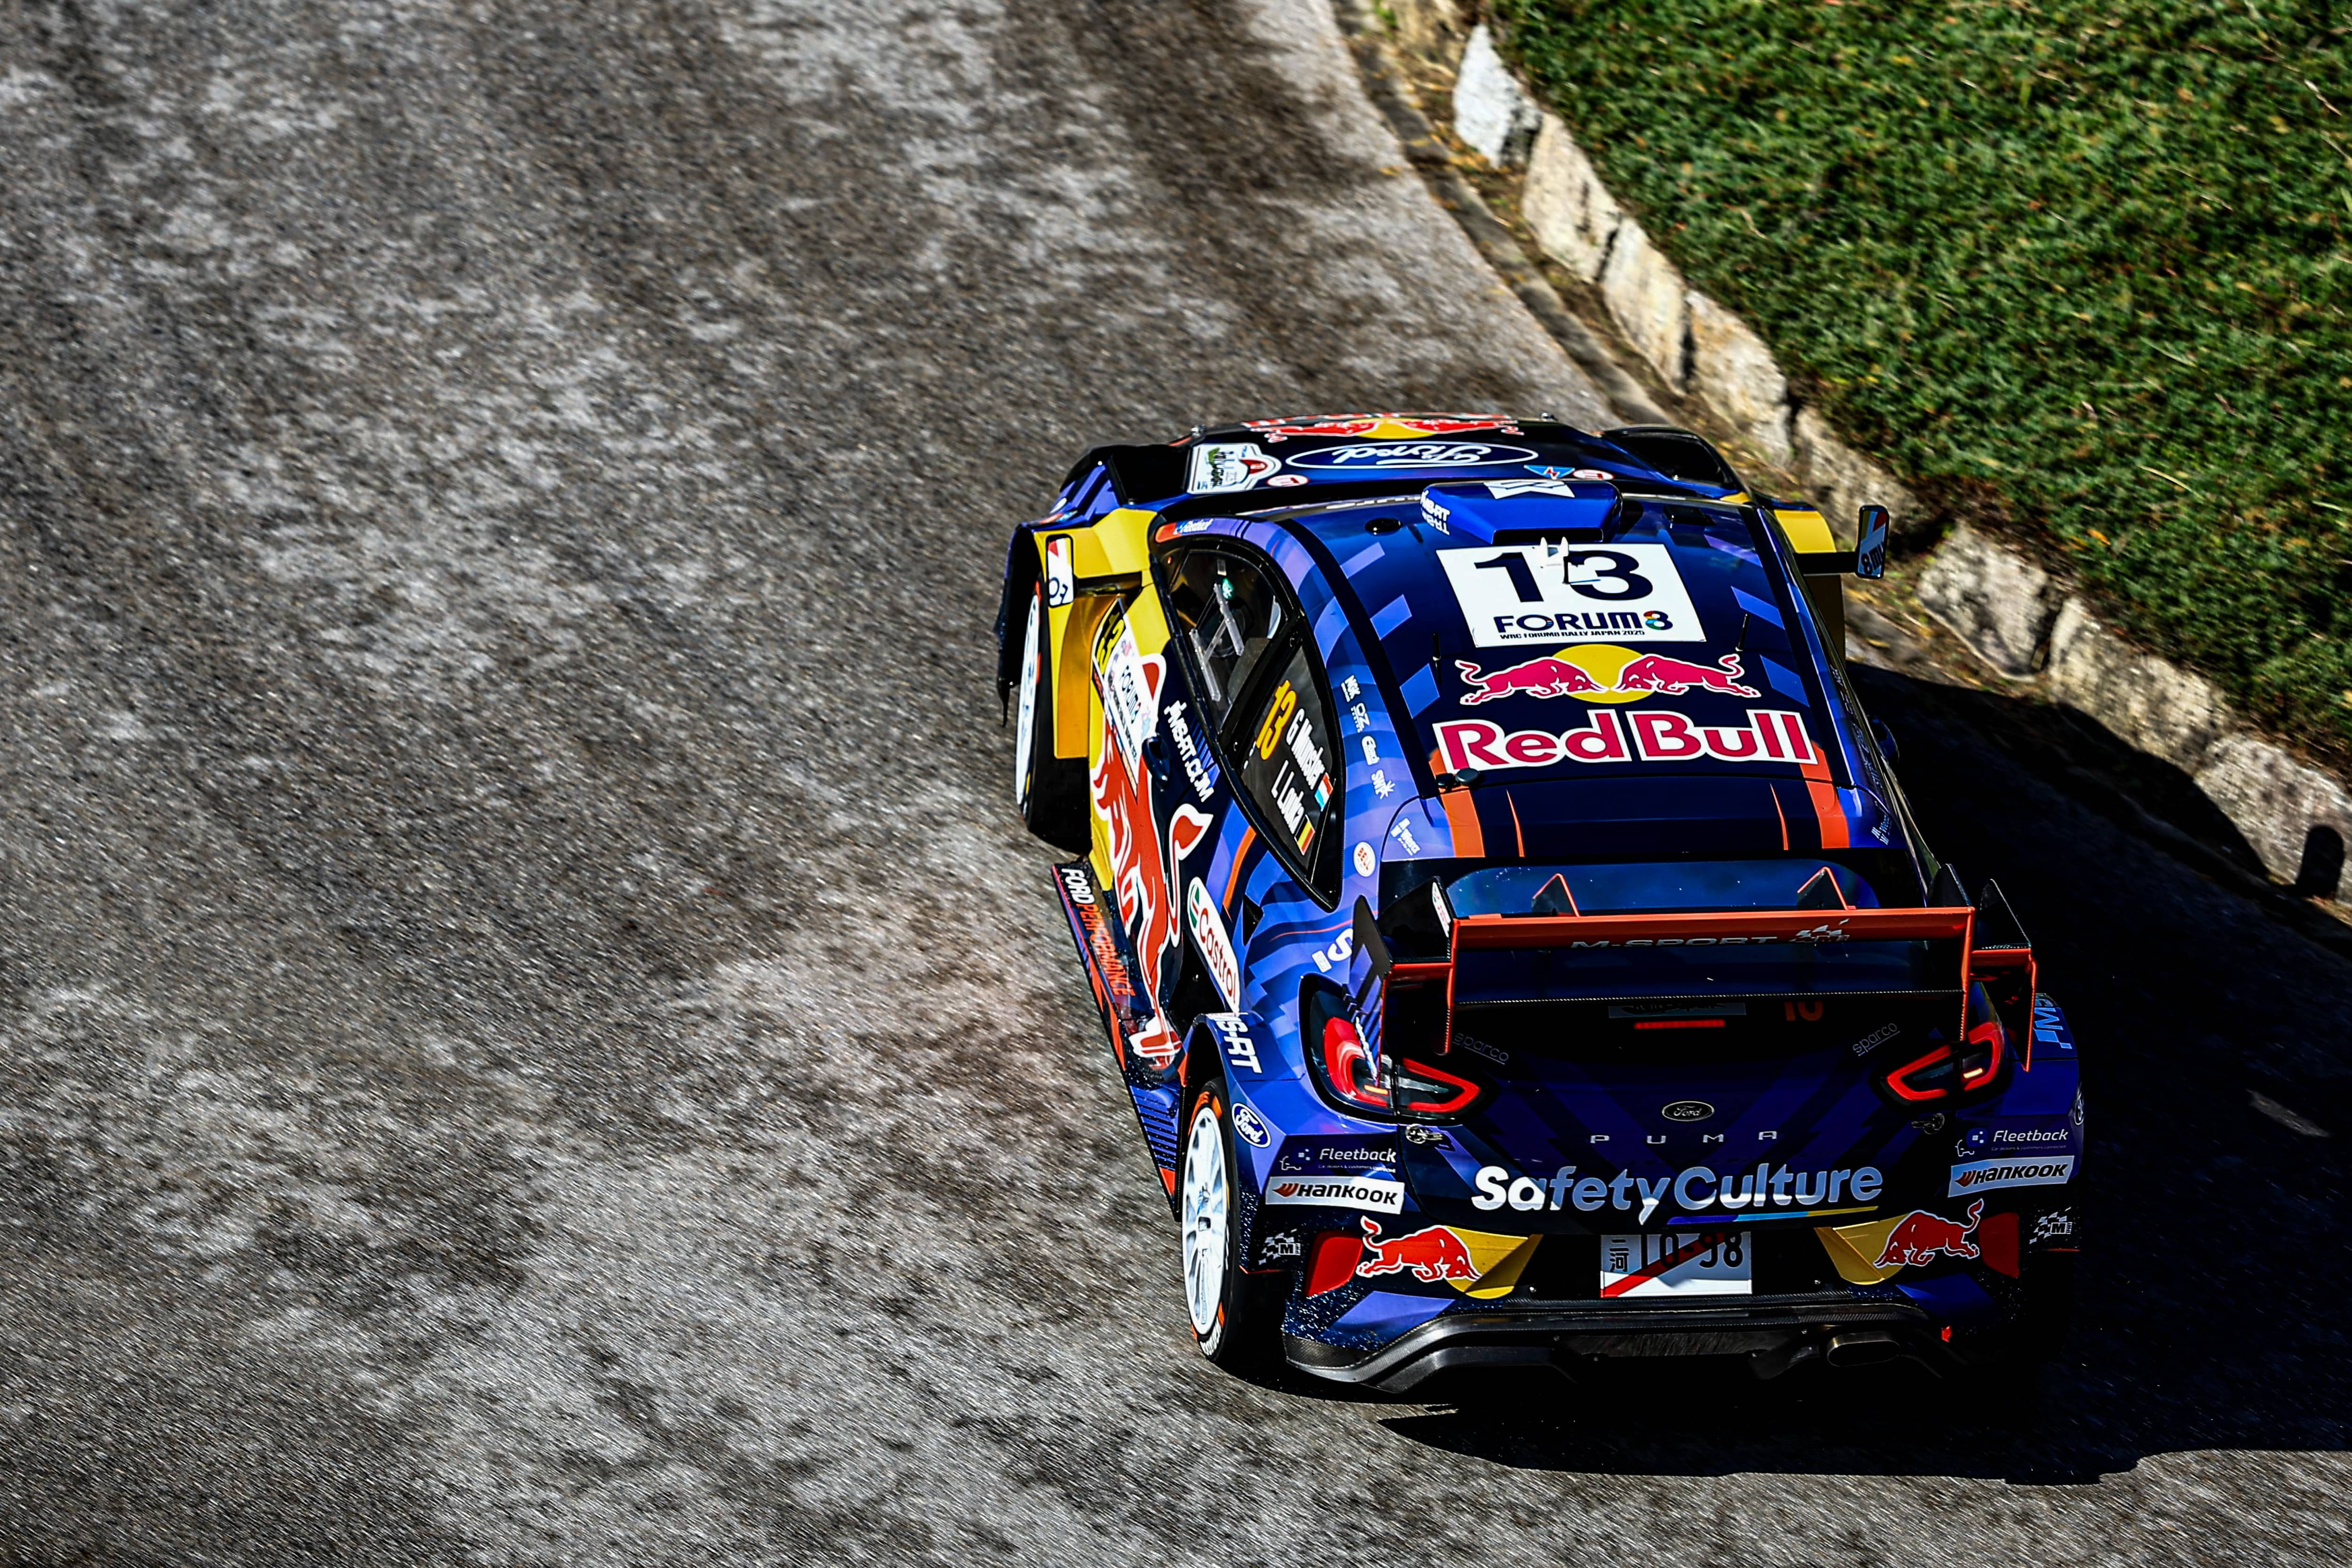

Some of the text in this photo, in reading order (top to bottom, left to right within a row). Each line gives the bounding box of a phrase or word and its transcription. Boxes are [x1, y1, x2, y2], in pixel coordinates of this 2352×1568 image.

[1331, 444, 1492, 466] Ford
[1474, 550, 1653, 602] 13
[1493, 610, 1673, 633] FORUM8
[1256, 680, 1297, 760] 13
[1286, 708, 1305, 745] G
[1434, 709, 1631, 771] Red
[1626, 709, 1817, 764] Bull
[1271, 760, 1289, 798] L
[1199, 907, 1236, 1005] Castrol
[1453, 1033, 1508, 1062] sparco
[1853, 1023, 1898, 1053] sparco
[1236, 1106, 1263, 1143] Ford
[1673, 1105, 1702, 1116] Ford
[1993, 1129, 2068, 1142] Fleetback
[1319, 1148, 1396, 1163] Fleetback
[1471, 1163, 1883, 1225] SafetyCulture
